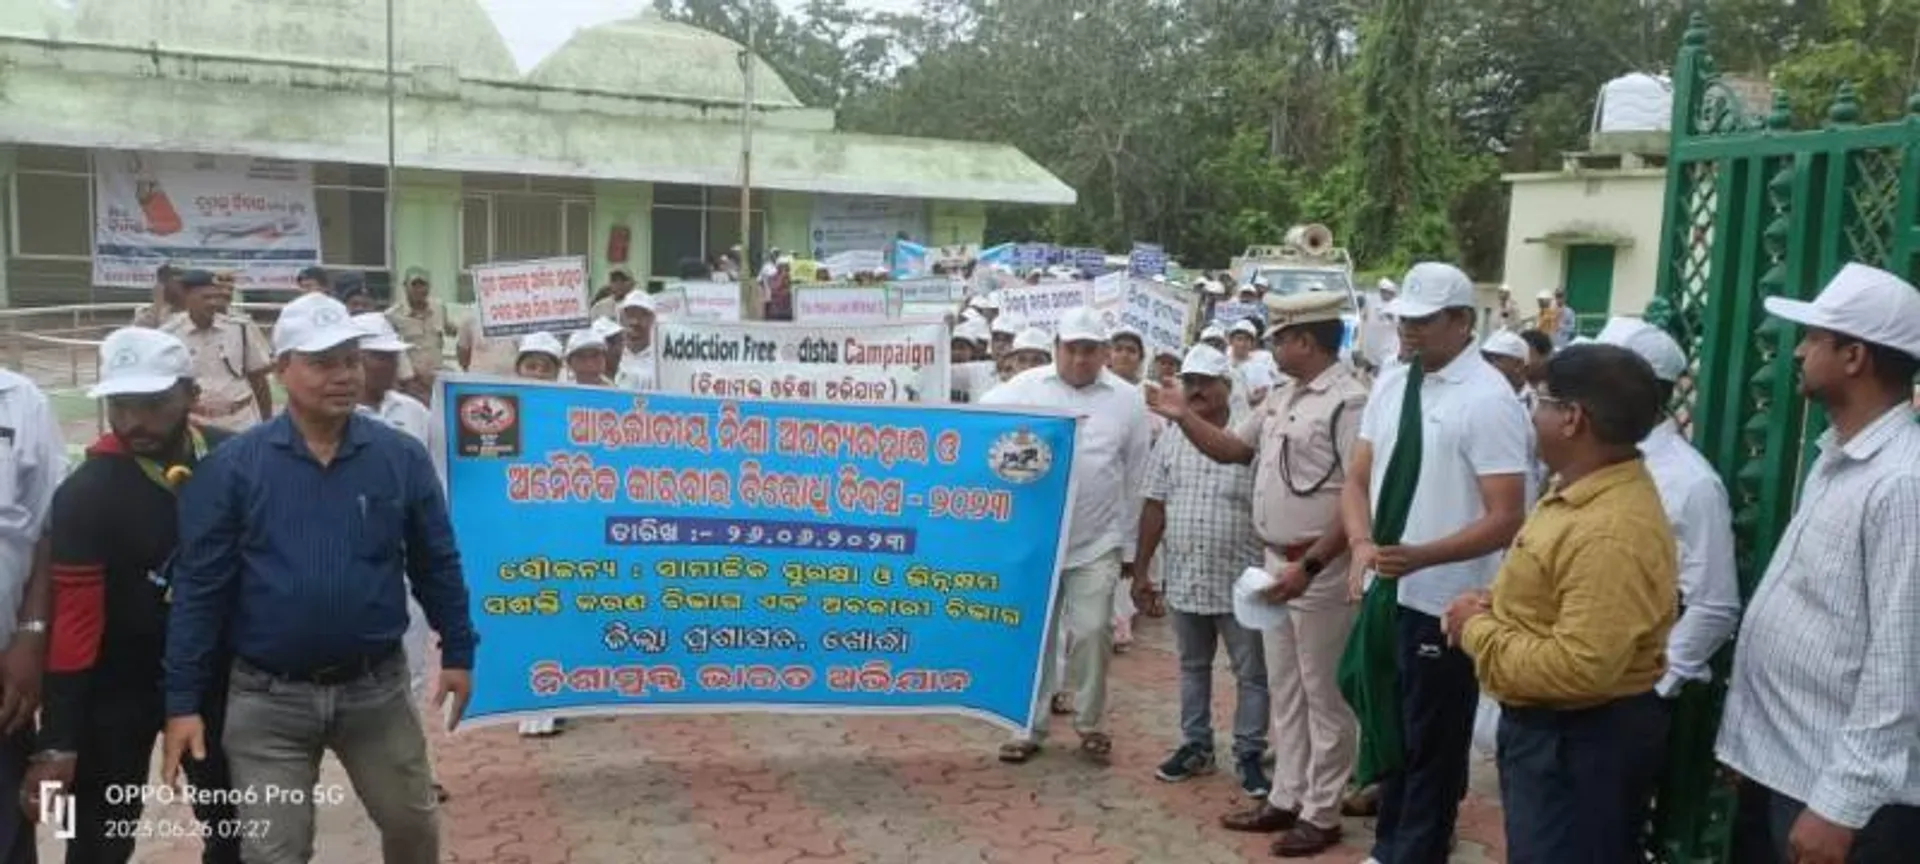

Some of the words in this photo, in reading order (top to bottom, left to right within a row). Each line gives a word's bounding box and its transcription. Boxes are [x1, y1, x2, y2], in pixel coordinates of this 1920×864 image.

[663, 332, 740, 361] Addiction
[743, 335, 776, 362] Free
[844, 337, 935, 371] Campaign
[717, 402, 769, 450] ନିଶା
[937, 429, 960, 463] ଓ
[626, 466, 731, 507] କାରବାର
[929, 485, 1012, 521] ୨୦୨୩
[609, 518, 679, 543] ତାରିଖ
[727, 524, 907, 551] ୨୬.୦୬.୨୦୨୩
[873, 565, 893, 586] ଓ
[661, 587, 742, 610] ବିଭାଗ
[945, 597, 1021, 626] ବିଭାଗ
[695, 663, 816, 692] ଭାରତ
[826, 660, 971, 694] ଅଭିଯାନ
